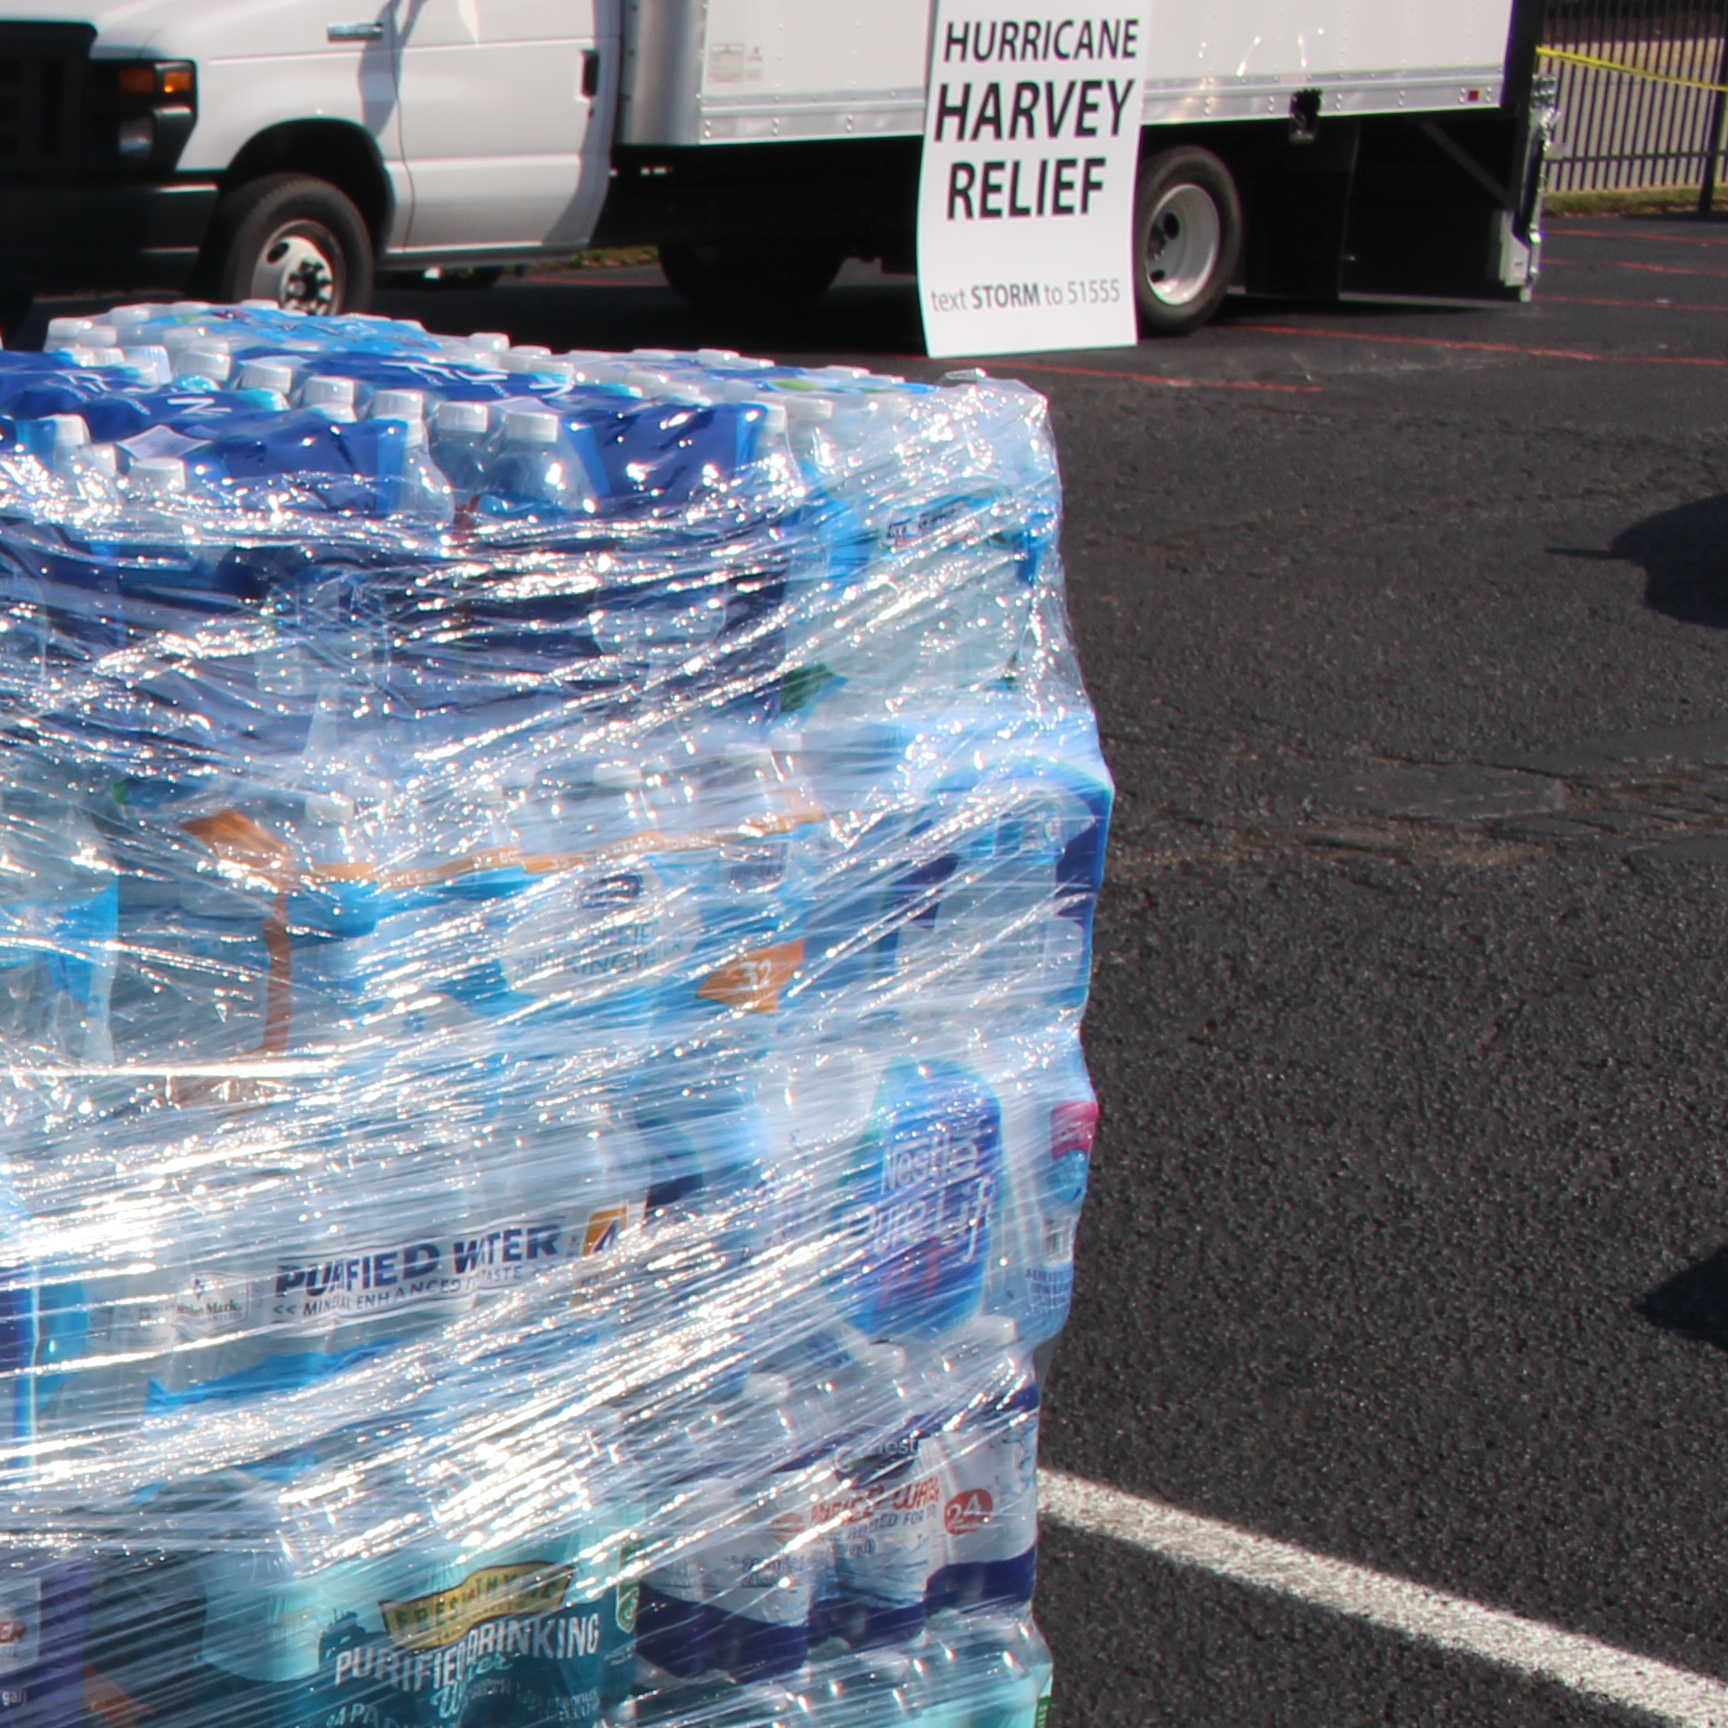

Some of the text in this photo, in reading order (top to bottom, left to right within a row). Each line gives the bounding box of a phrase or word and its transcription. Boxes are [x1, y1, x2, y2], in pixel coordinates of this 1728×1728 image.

[943, 18, 1139, 63] HURRICANE
[933, 79, 1136, 142] HARVEY
[946, 157, 1106, 221] RELIEF
[930, 278, 1121, 313] text STORM to 51555
[735, 959, 773, 991] 32
[946, 1492, 985, 1529] 24
